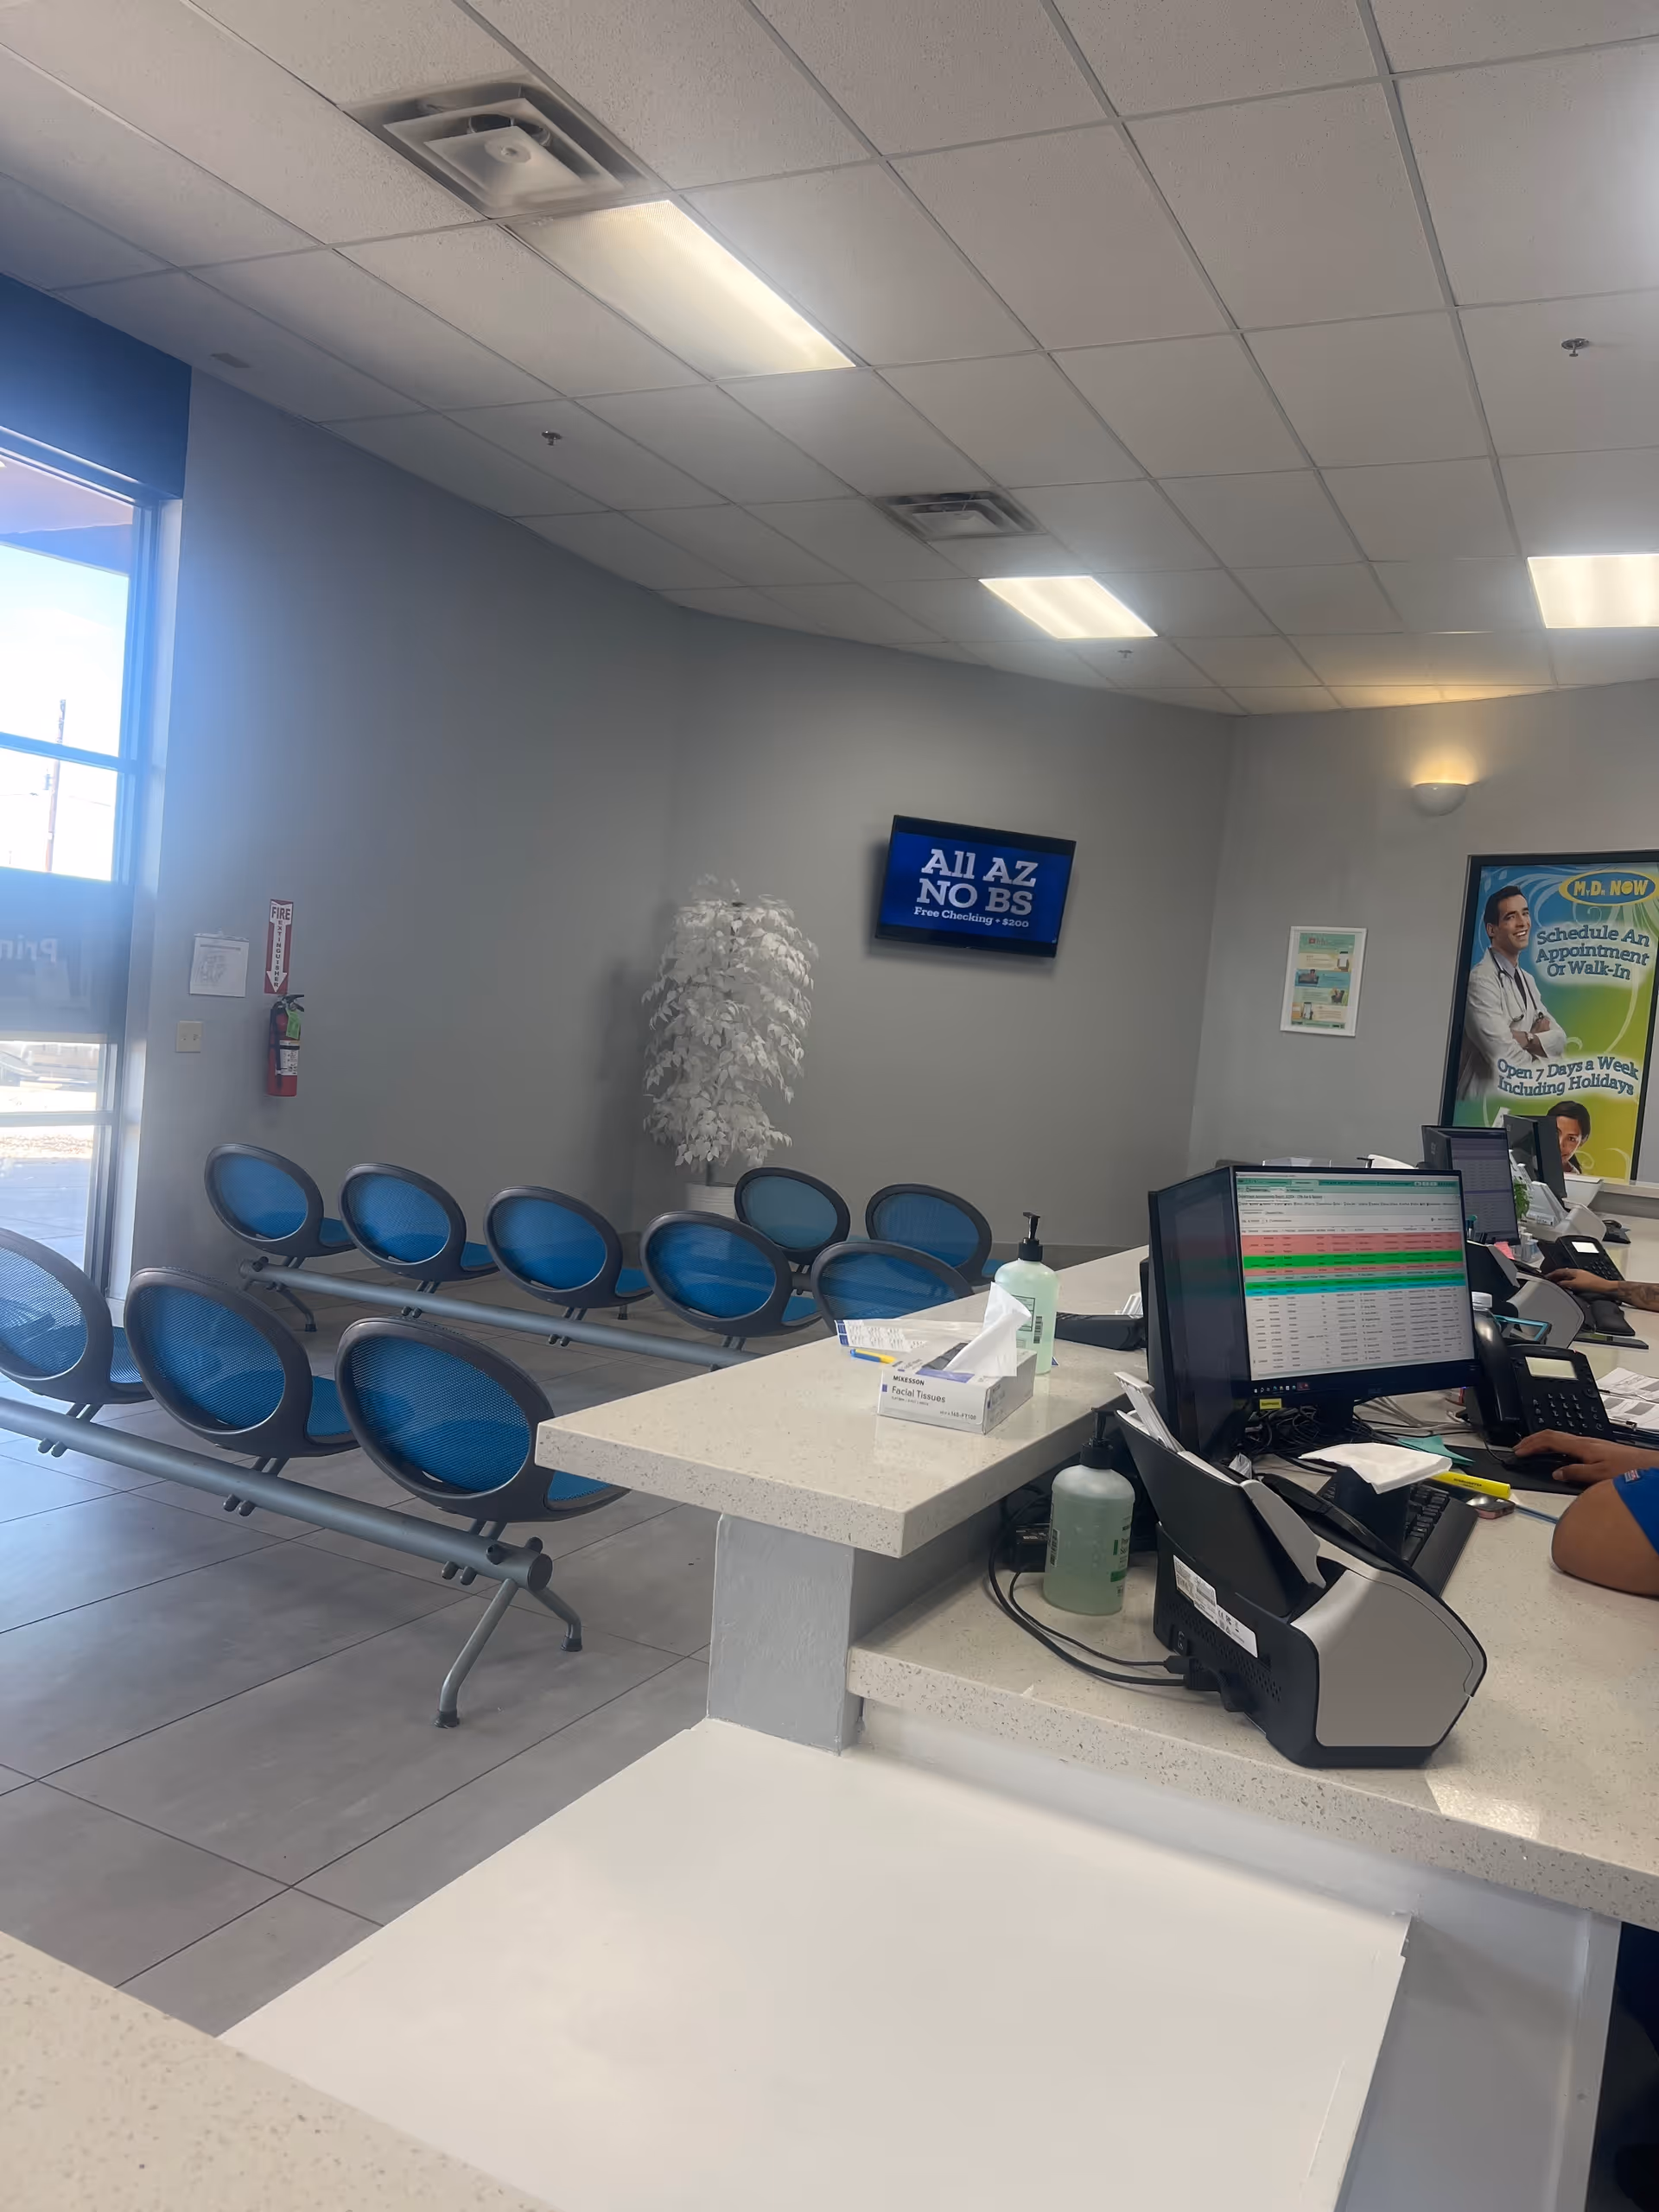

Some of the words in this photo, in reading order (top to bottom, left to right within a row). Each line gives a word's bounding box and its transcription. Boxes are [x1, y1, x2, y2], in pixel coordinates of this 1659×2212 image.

[921, 849, 976, 880] All
[982, 857, 1039, 887] AZ
[917, 878, 978, 908] NO
[985, 887, 1033, 916] BS
[1610, 880, 1649, 897] NOW
[271, 906, 291, 921] FIRE
[913, 906, 939, 918] Free
[941, 910, 994, 925] Checking
[1002, 918, 1029, 928] $200
[1536, 925, 1619, 945] Schedule
[1621, 929, 1650, 947] An
[274, 919, 283, 988] EXTINGUISHER
[1535, 943, 1649, 966] Appointment
[1547, 963, 1566, 977] Or
[1567, 960, 1630, 980] Walk-In
[1497, 1058, 1533, 1079] Open
[1535, 1069, 1545, 1082] 7
[1547, 1061, 1583, 1077] Days
[1585, 1059, 1594, 1071] a
[1598, 1056, 1639, 1080] Week
[1497, 1075, 1566, 1096] Including
[1568, 1074, 1634, 1096] Holidays
[892, 1385, 915, 1397] Facial
[917, 1389, 946, 1403] Tissues
